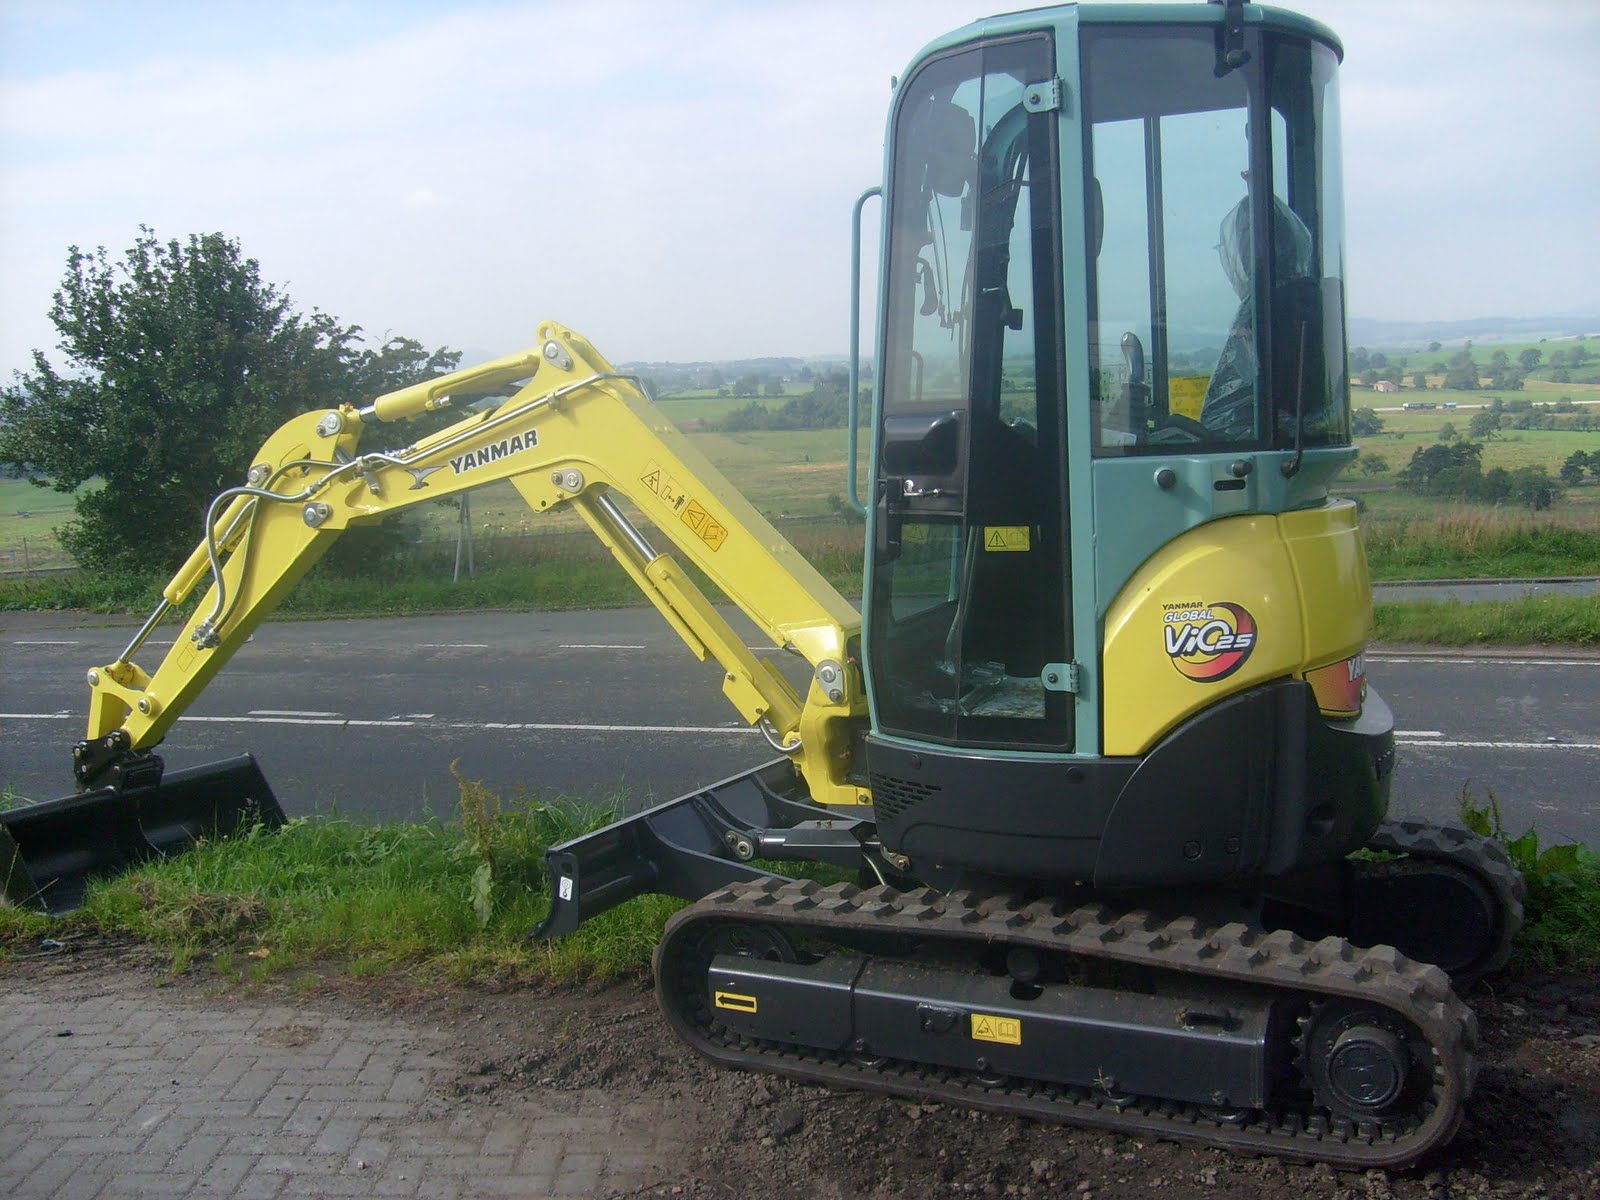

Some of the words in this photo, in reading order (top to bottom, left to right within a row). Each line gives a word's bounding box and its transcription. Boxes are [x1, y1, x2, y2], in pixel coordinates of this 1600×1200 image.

[450, 429, 538, 475] YANMAR
[1162, 601, 1203, 611] YANMAR
[1163, 609, 1215, 622] GLOBAL
